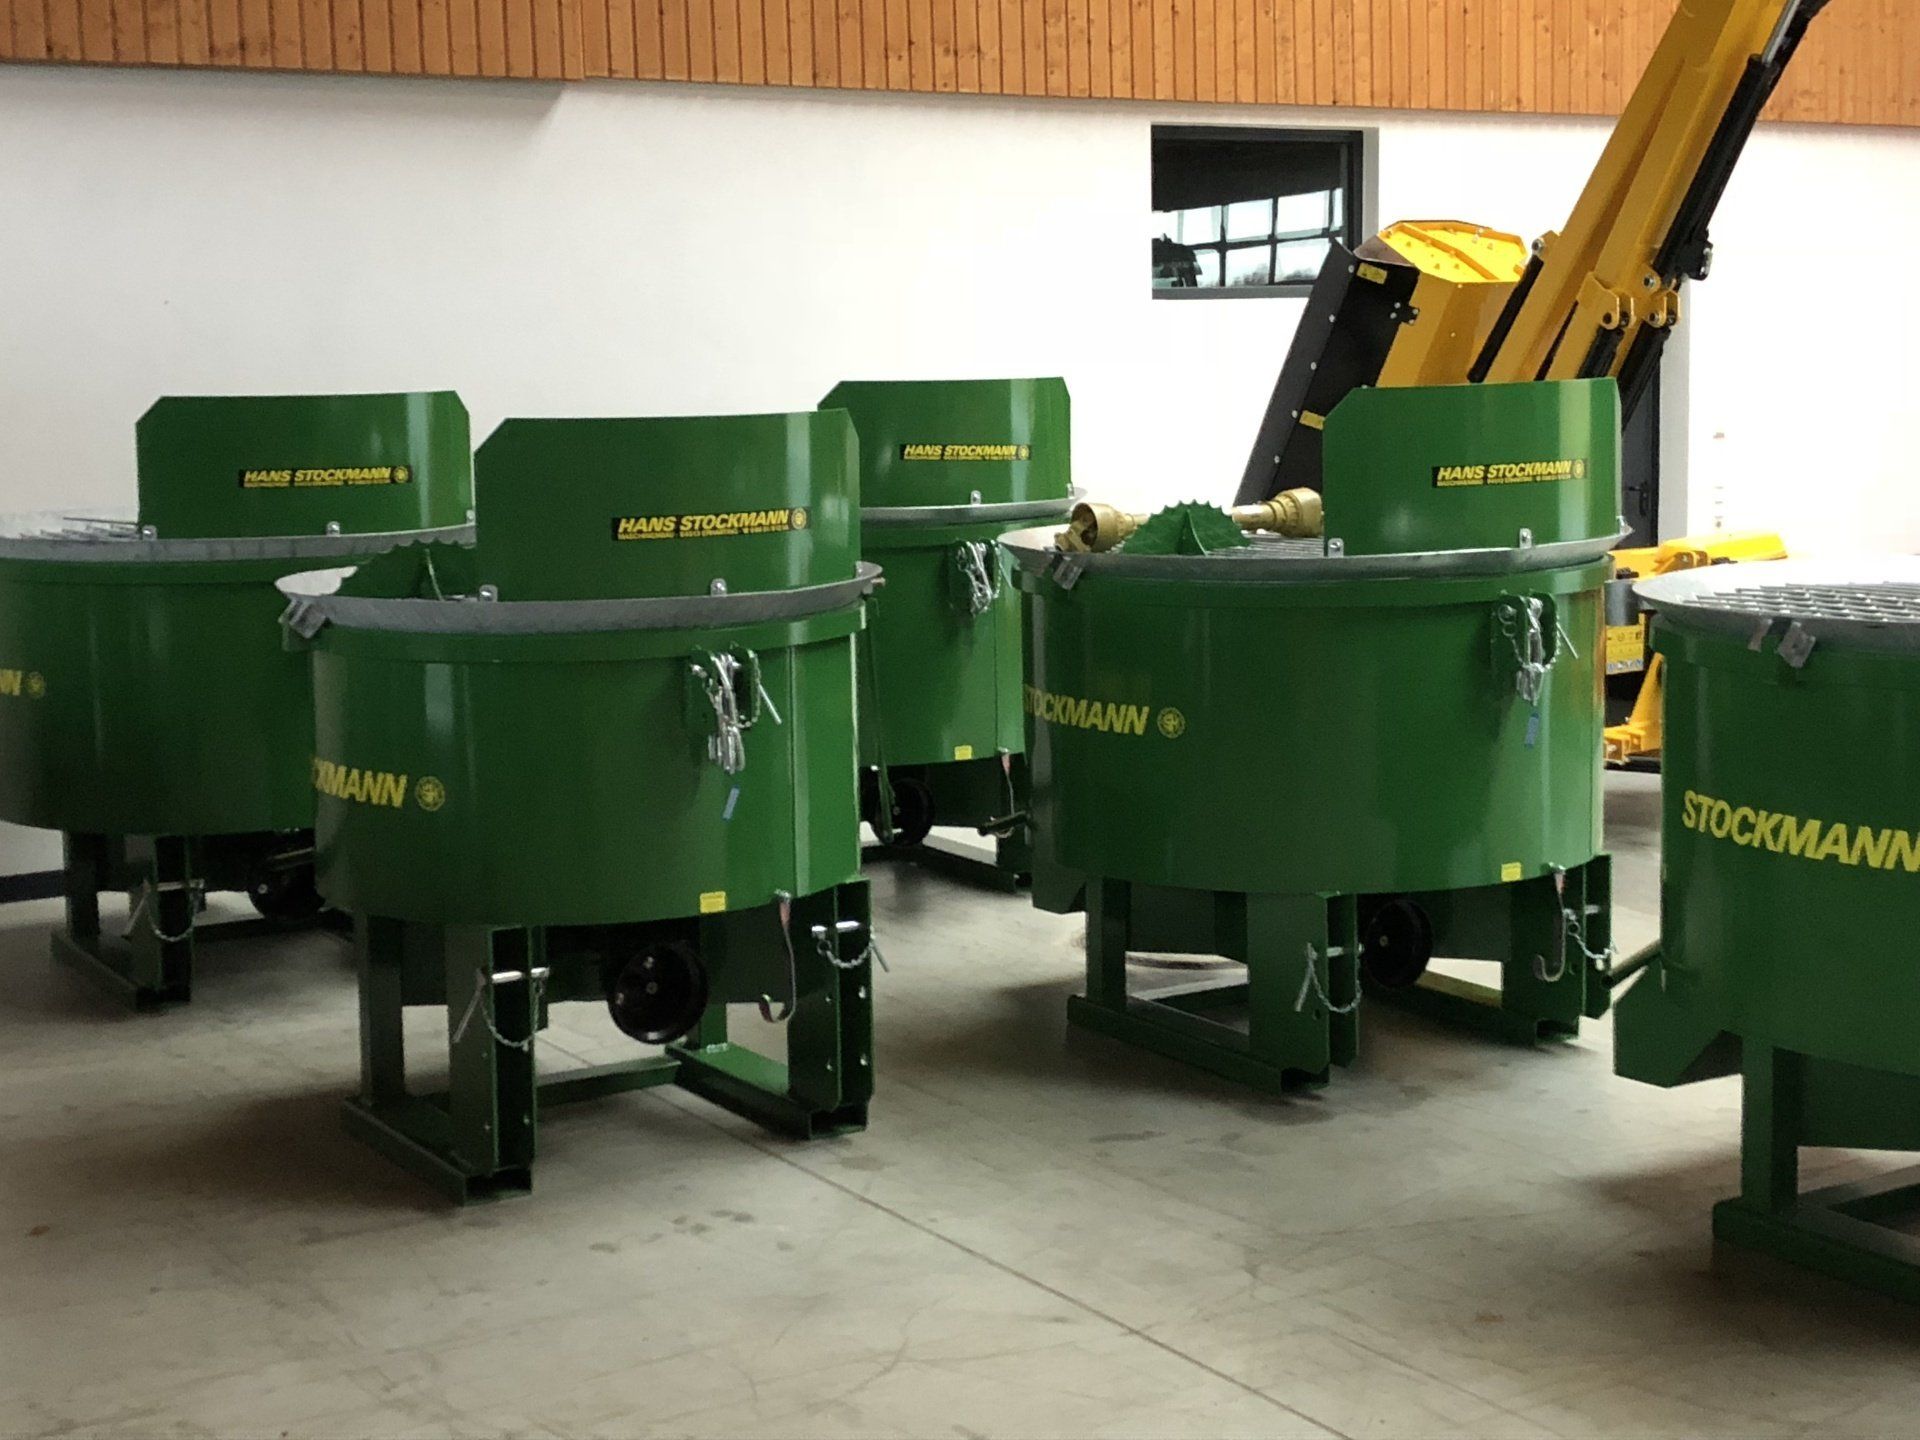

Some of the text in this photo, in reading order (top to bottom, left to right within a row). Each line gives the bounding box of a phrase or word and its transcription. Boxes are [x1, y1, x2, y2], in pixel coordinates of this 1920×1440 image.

[904, 445, 942, 456] HANS
[944, 444, 1017, 456] STOCKMANN
[244, 470, 291, 482] HANS
[294, 467, 391, 481] STOCKMANN
[1437, 465, 1485, 480] HANS
[1487, 460, 1572, 478] STOCKMANN
[618, 516, 676, 533] HANS
[679, 509, 790, 531] STOCKMANN
[1682, 790, 1920, 873] STOCKMANN
